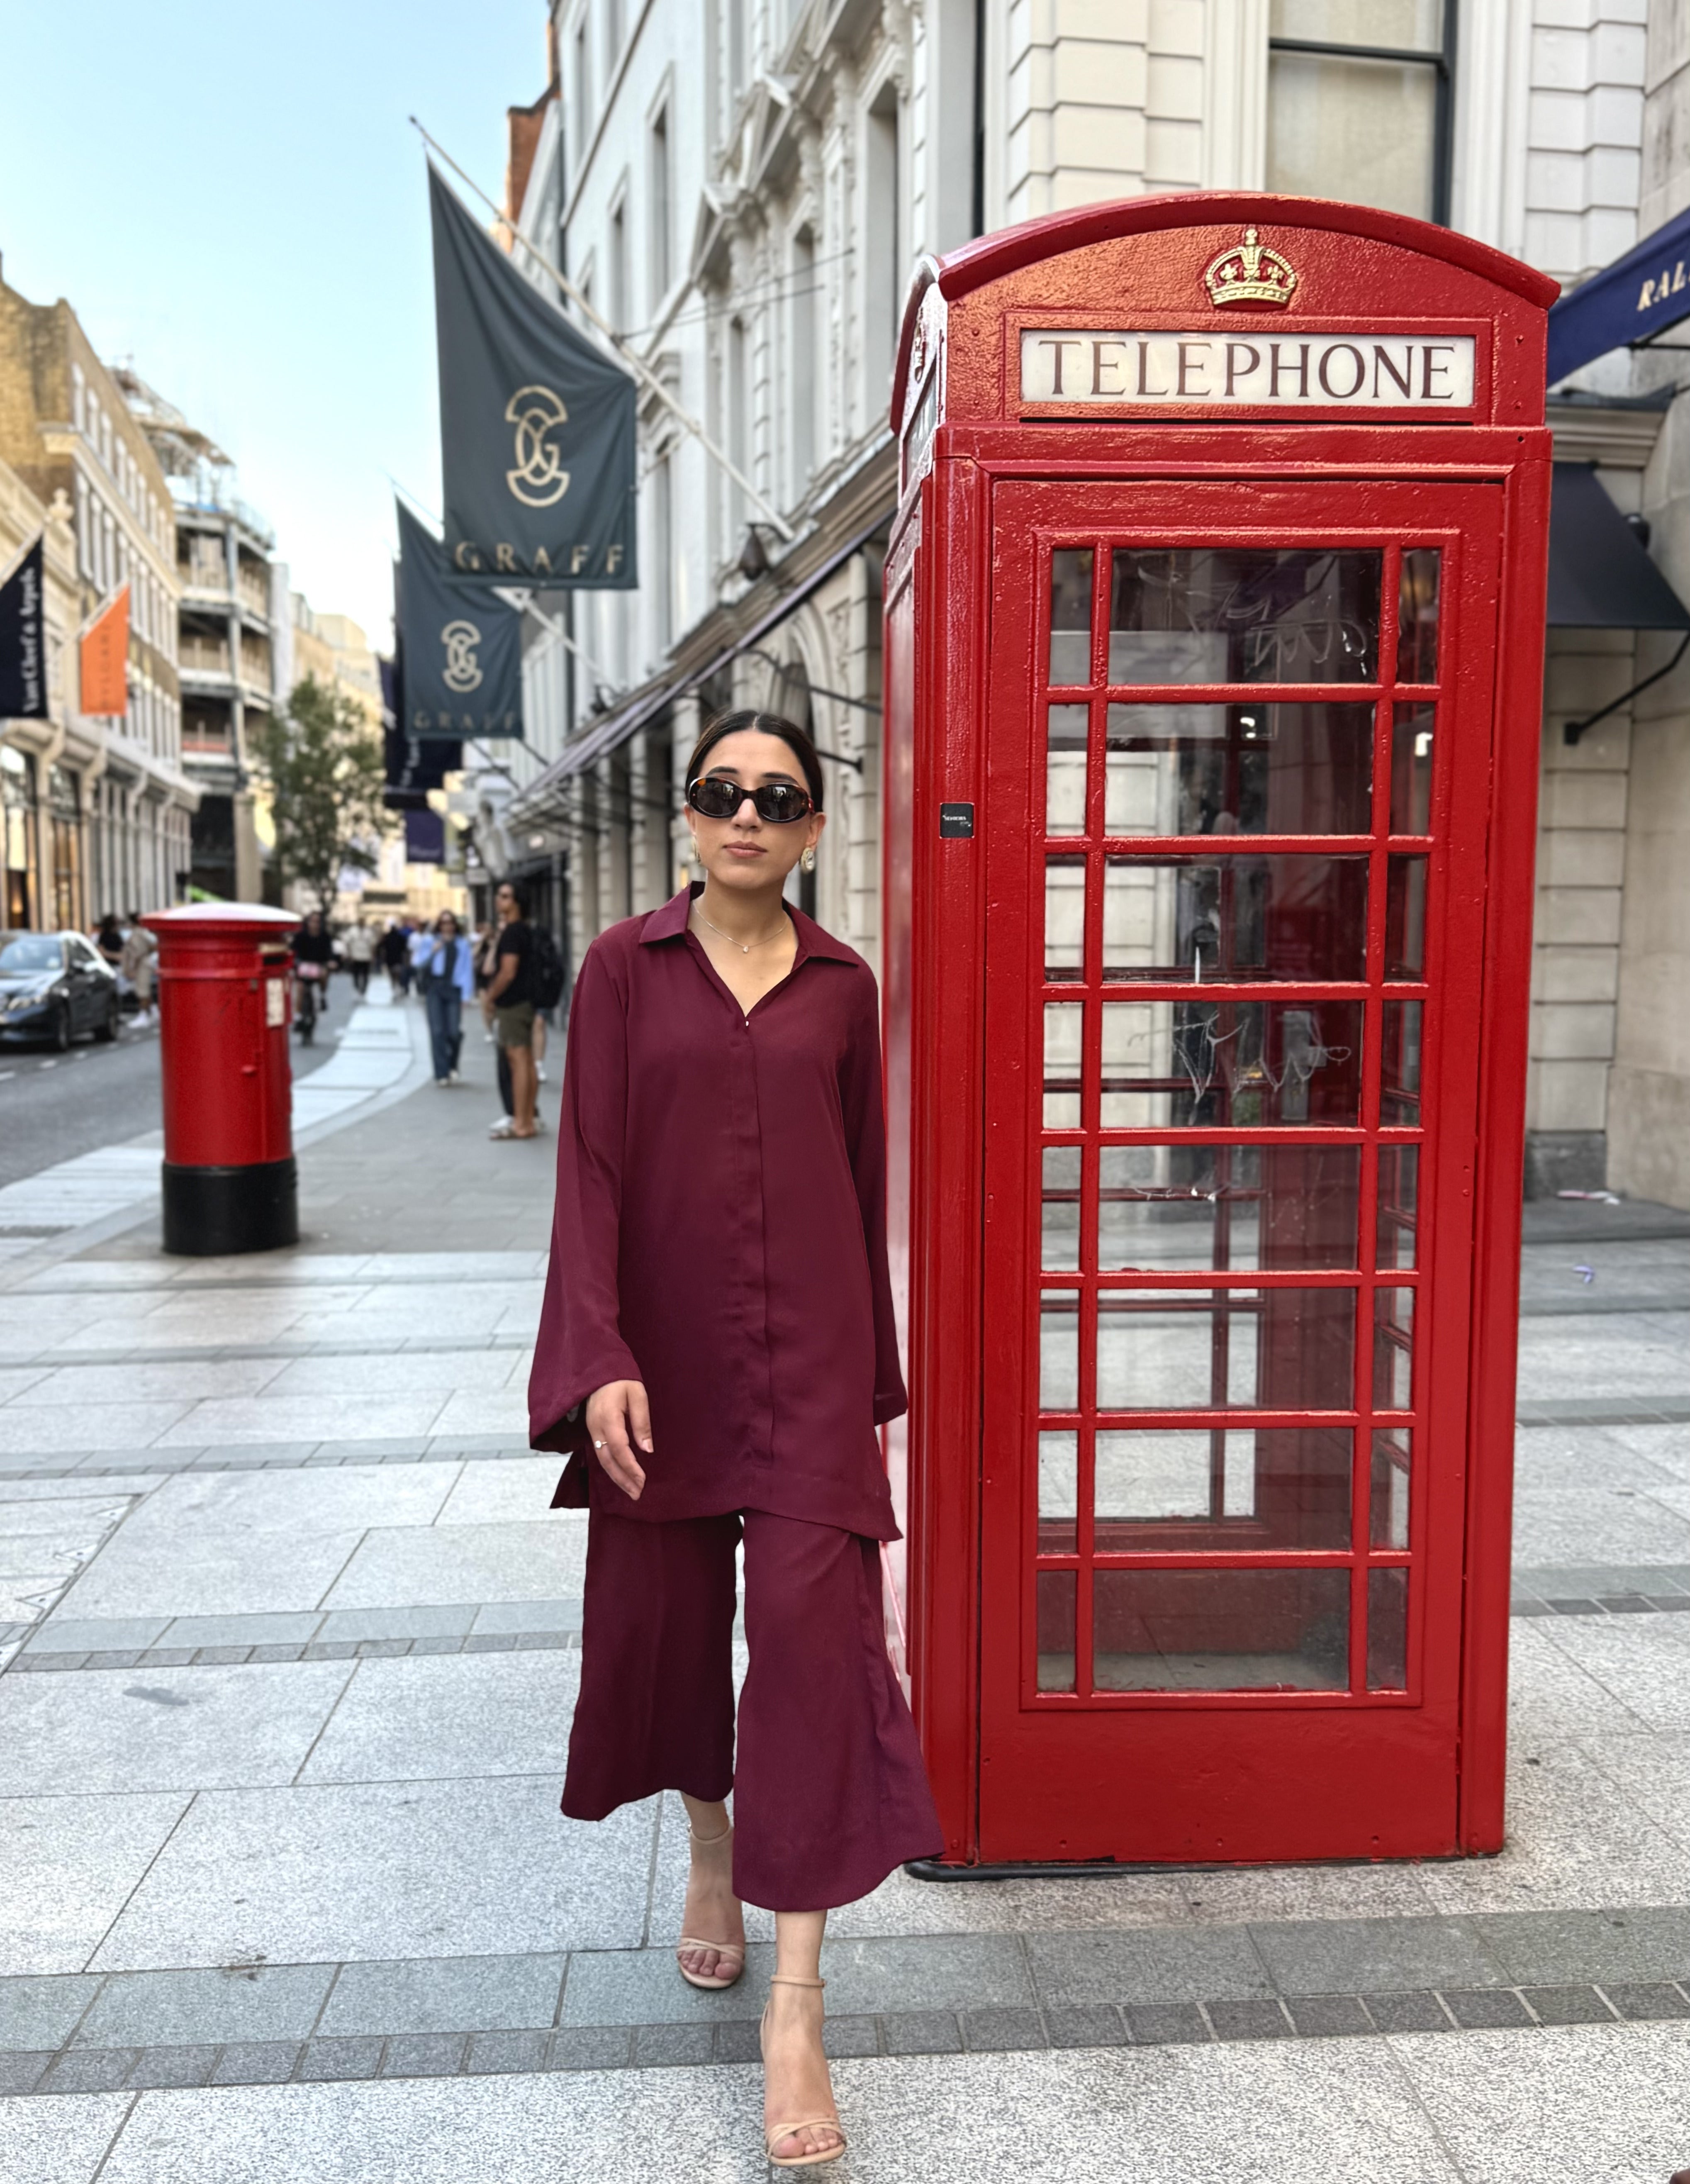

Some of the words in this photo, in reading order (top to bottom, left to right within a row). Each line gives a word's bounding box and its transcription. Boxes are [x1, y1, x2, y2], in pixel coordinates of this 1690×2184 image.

[1636, 261, 1690, 312] RAL
[1038, 340, 1455, 401] TELEPHONE
[455, 541, 624, 574] GRAFF
[414, 710, 517, 731] GRAFF
